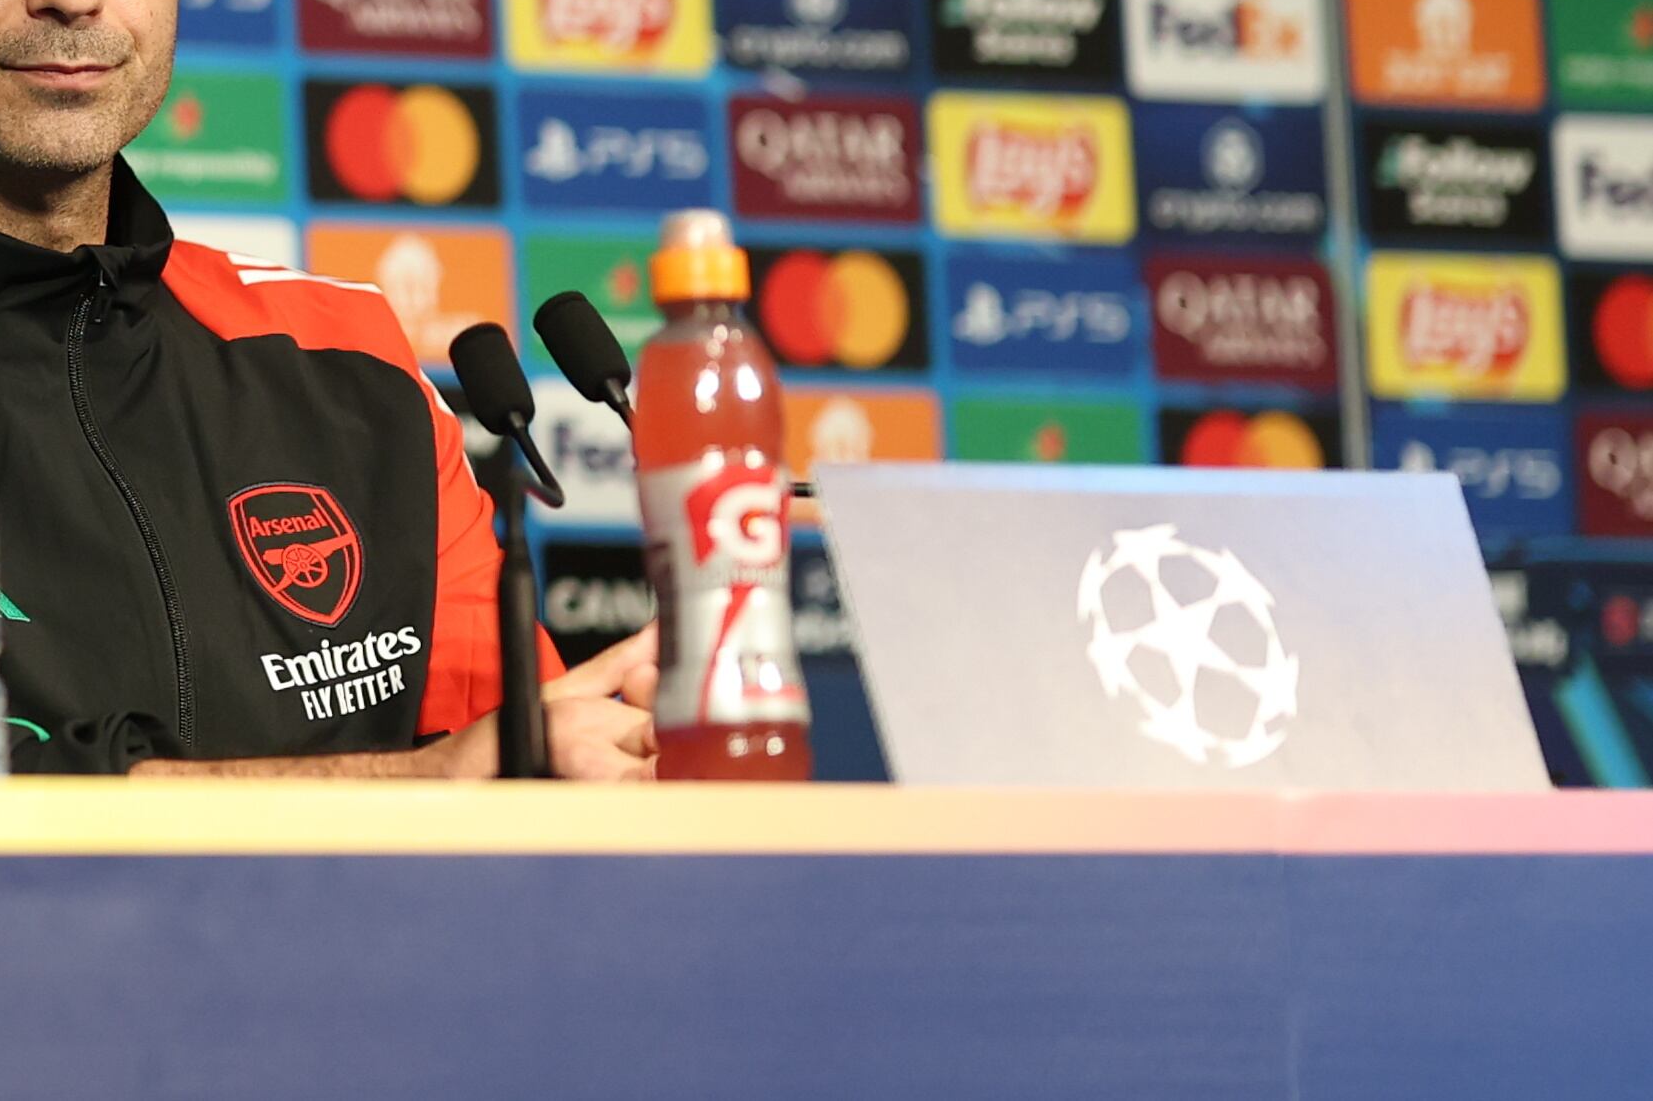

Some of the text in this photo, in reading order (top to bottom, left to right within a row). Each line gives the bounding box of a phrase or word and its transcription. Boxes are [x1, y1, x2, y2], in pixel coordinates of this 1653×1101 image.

[249, 508, 329, 538] Arsenal
[707, 483, 783, 568] G
[260, 626, 422, 691] Emirates
[300, 663, 406, 721] FLY BETTER
